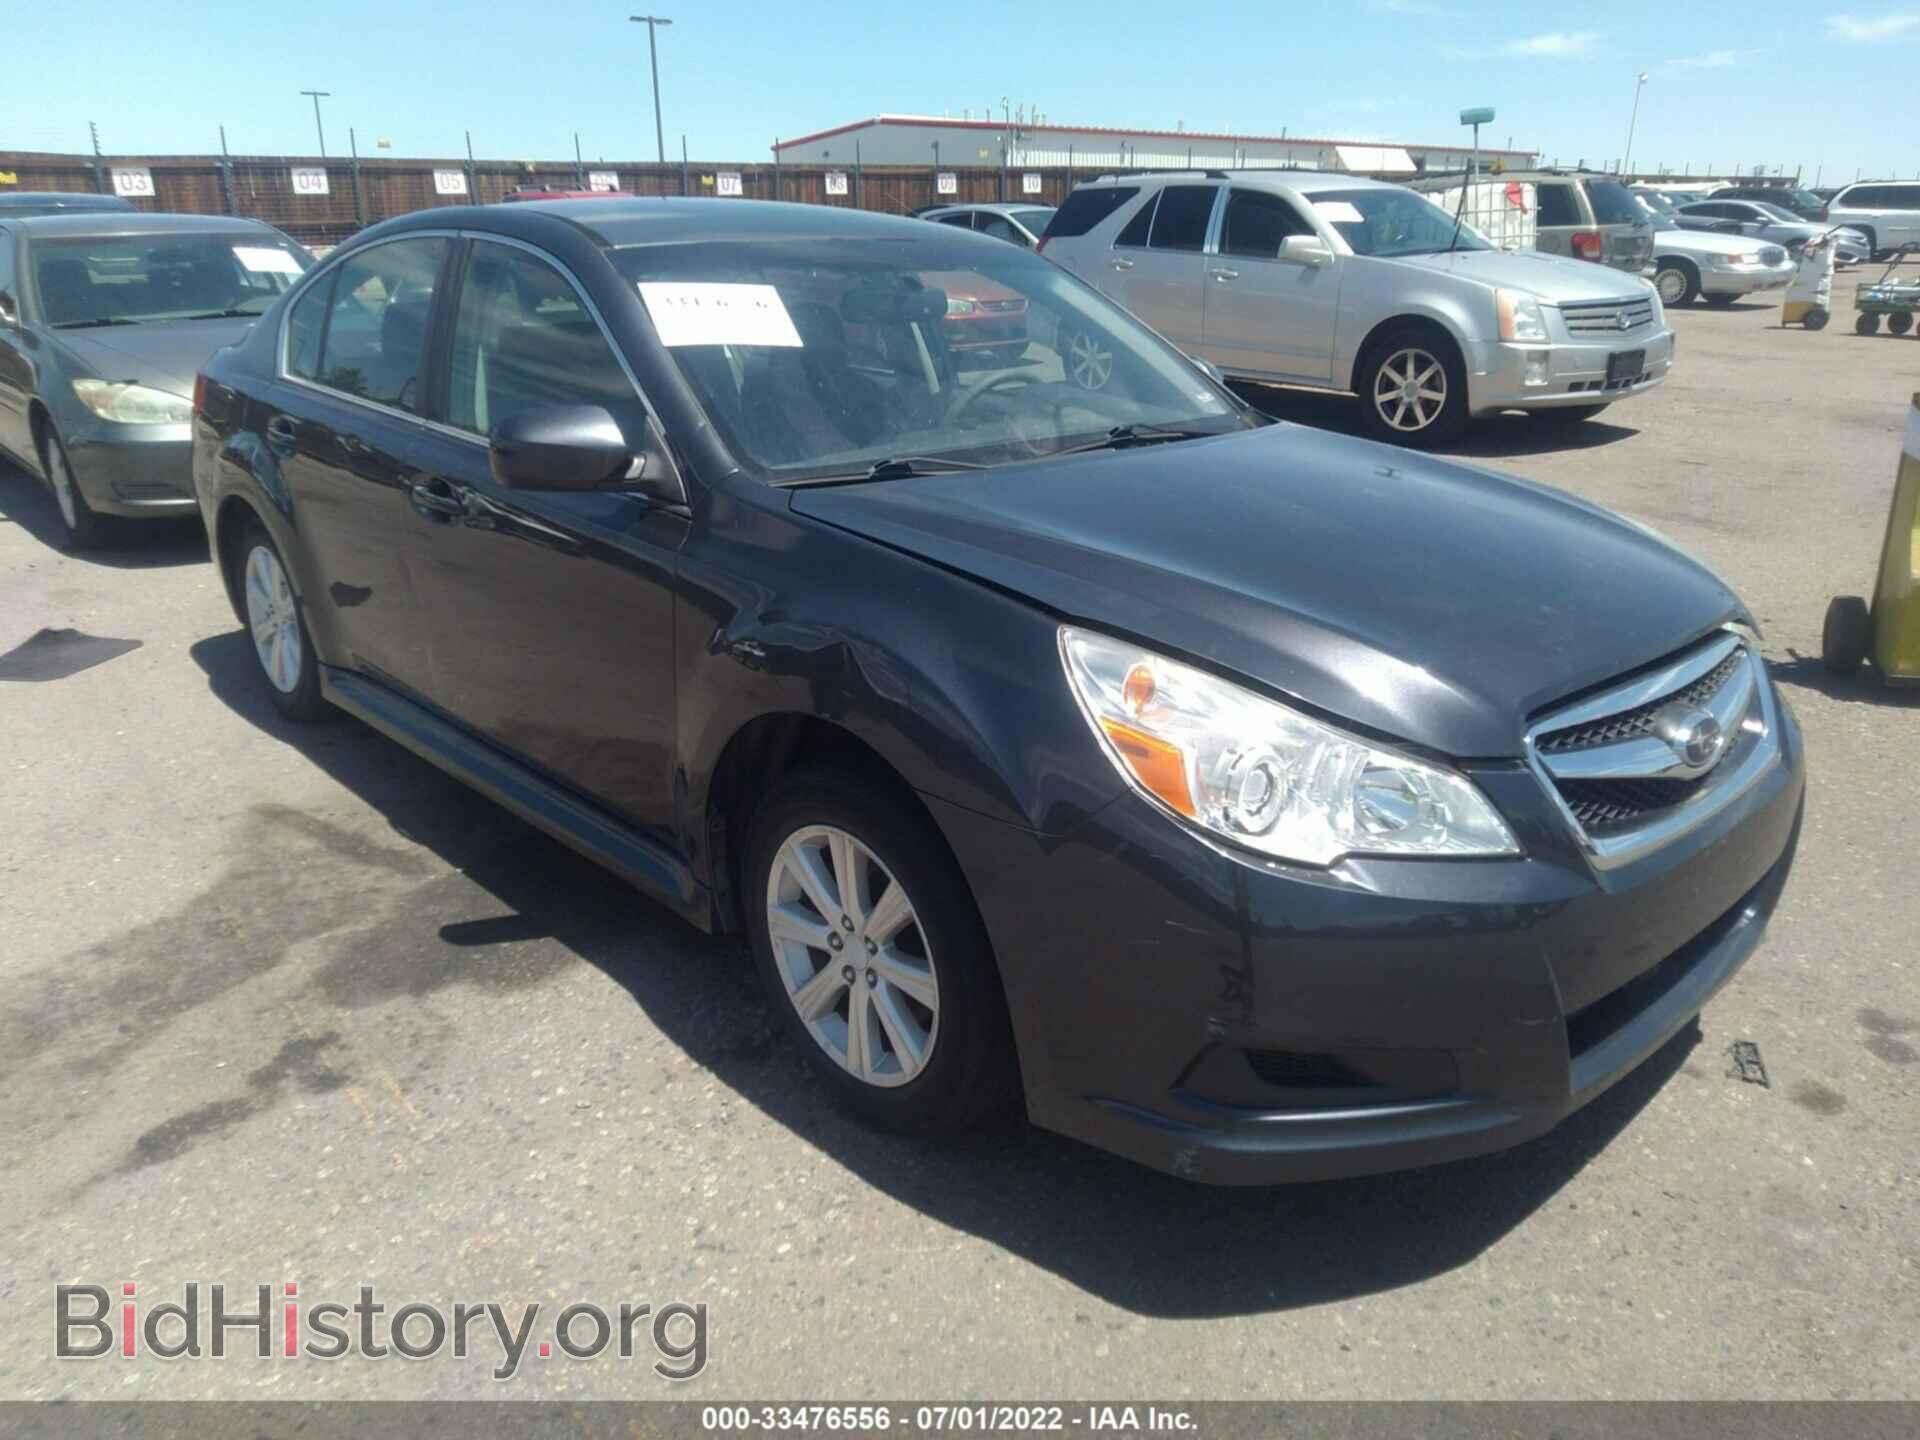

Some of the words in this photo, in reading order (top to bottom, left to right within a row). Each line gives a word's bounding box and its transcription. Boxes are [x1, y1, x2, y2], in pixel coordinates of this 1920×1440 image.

[121, 171, 147, 190] 03
[300, 171, 323, 190] 04
[440, 171, 461, 190] 05
[721, 175, 738, 190] 07
[1027, 175, 1040, 190] 10
